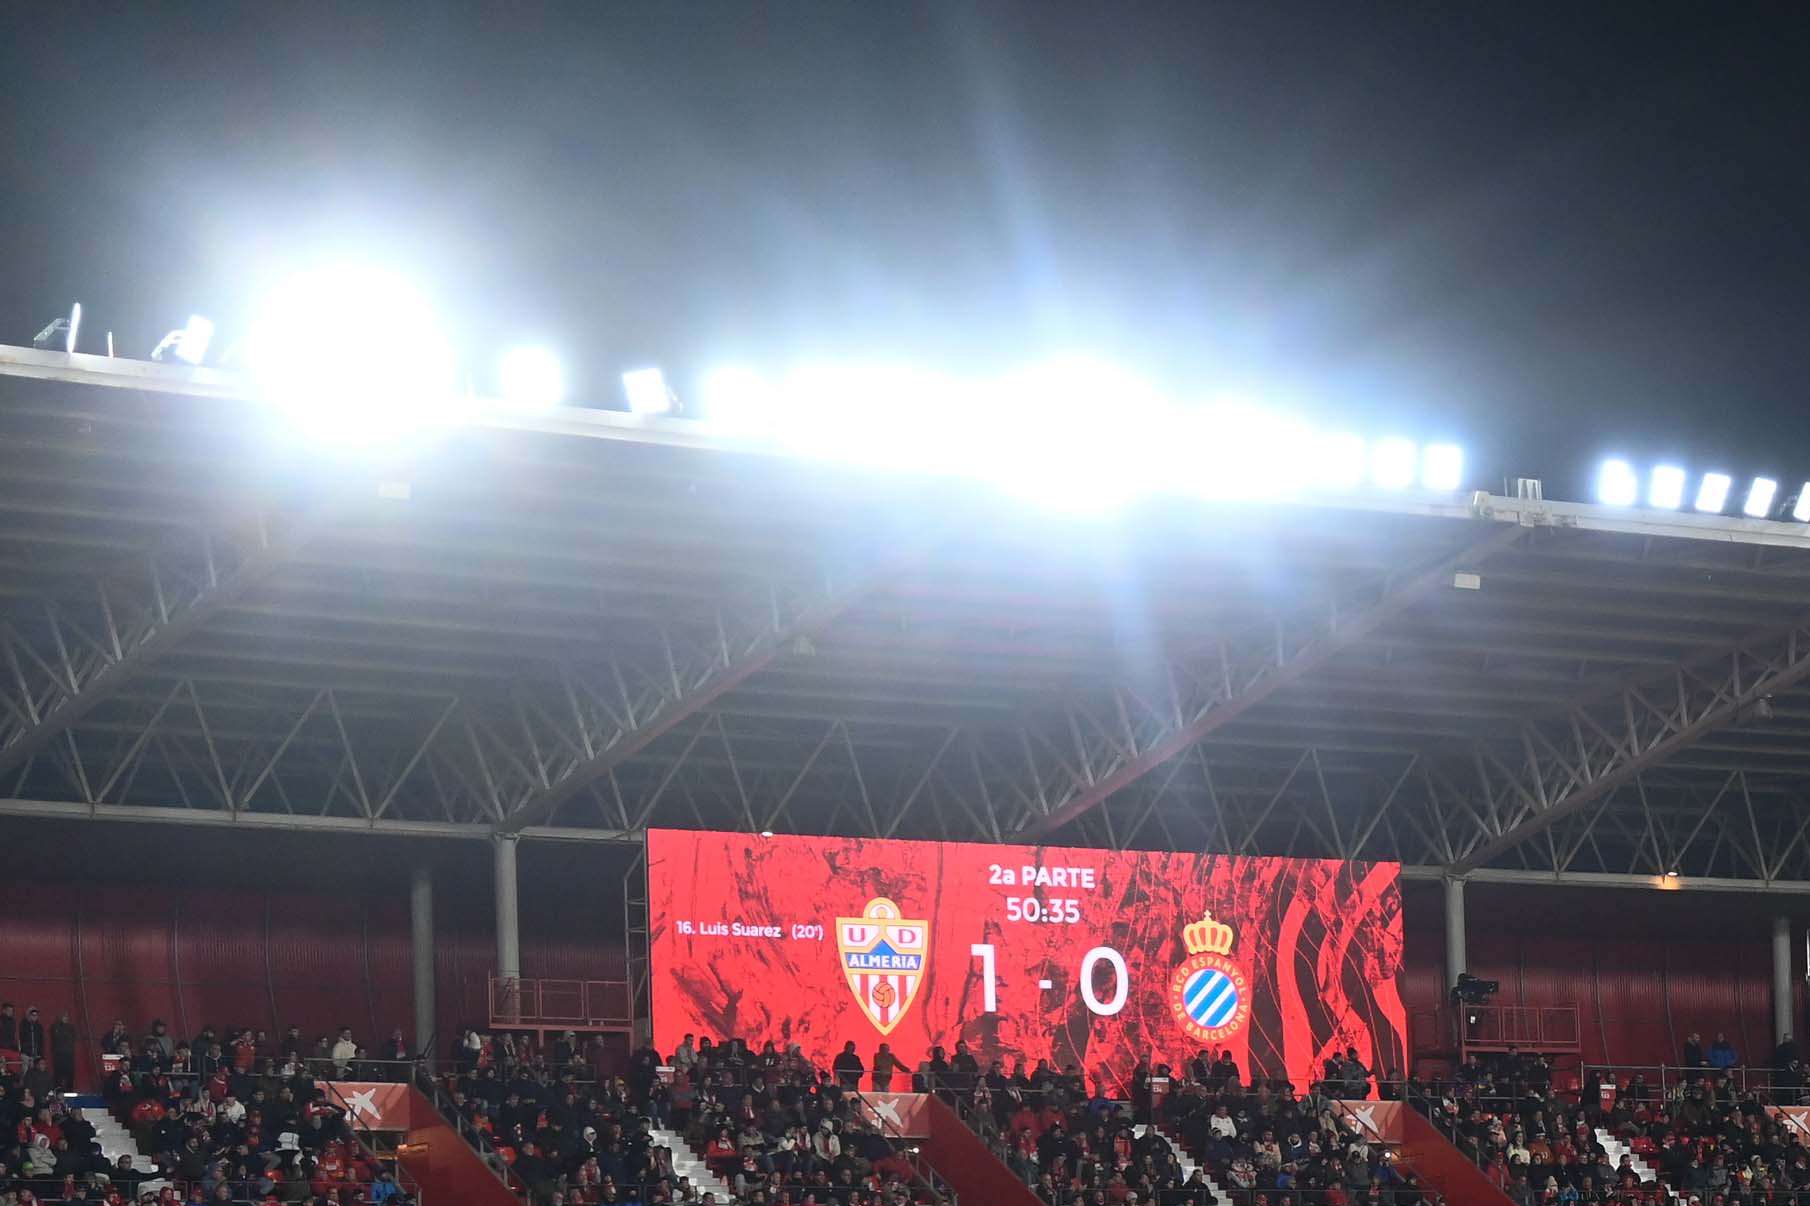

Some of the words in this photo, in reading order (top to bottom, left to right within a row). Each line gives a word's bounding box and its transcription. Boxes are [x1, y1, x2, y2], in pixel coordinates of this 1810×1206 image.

[988, 864, 1016, 885] 2a
[1021, 865, 1096, 889] PARTE
[1006, 896, 1081, 924] 50:35
[676, 920, 696, 934] 16.
[700, 921, 729, 936] Luis
[731, 922, 782, 938] Suarez
[848, 927, 866, 943] U
[897, 928, 917, 944] D
[848, 953, 918, 970] ALMERIA
[970, 943, 997, 1013] 1
[1080, 946, 1129, 1016] 0
[1173, 967, 1190, 993] RCD
[1191, 956, 1247, 995] ESPANYOL
[1173, 1003, 1187, 1021] DE
[1185, 1003, 1248, 1041] BARCELONA
